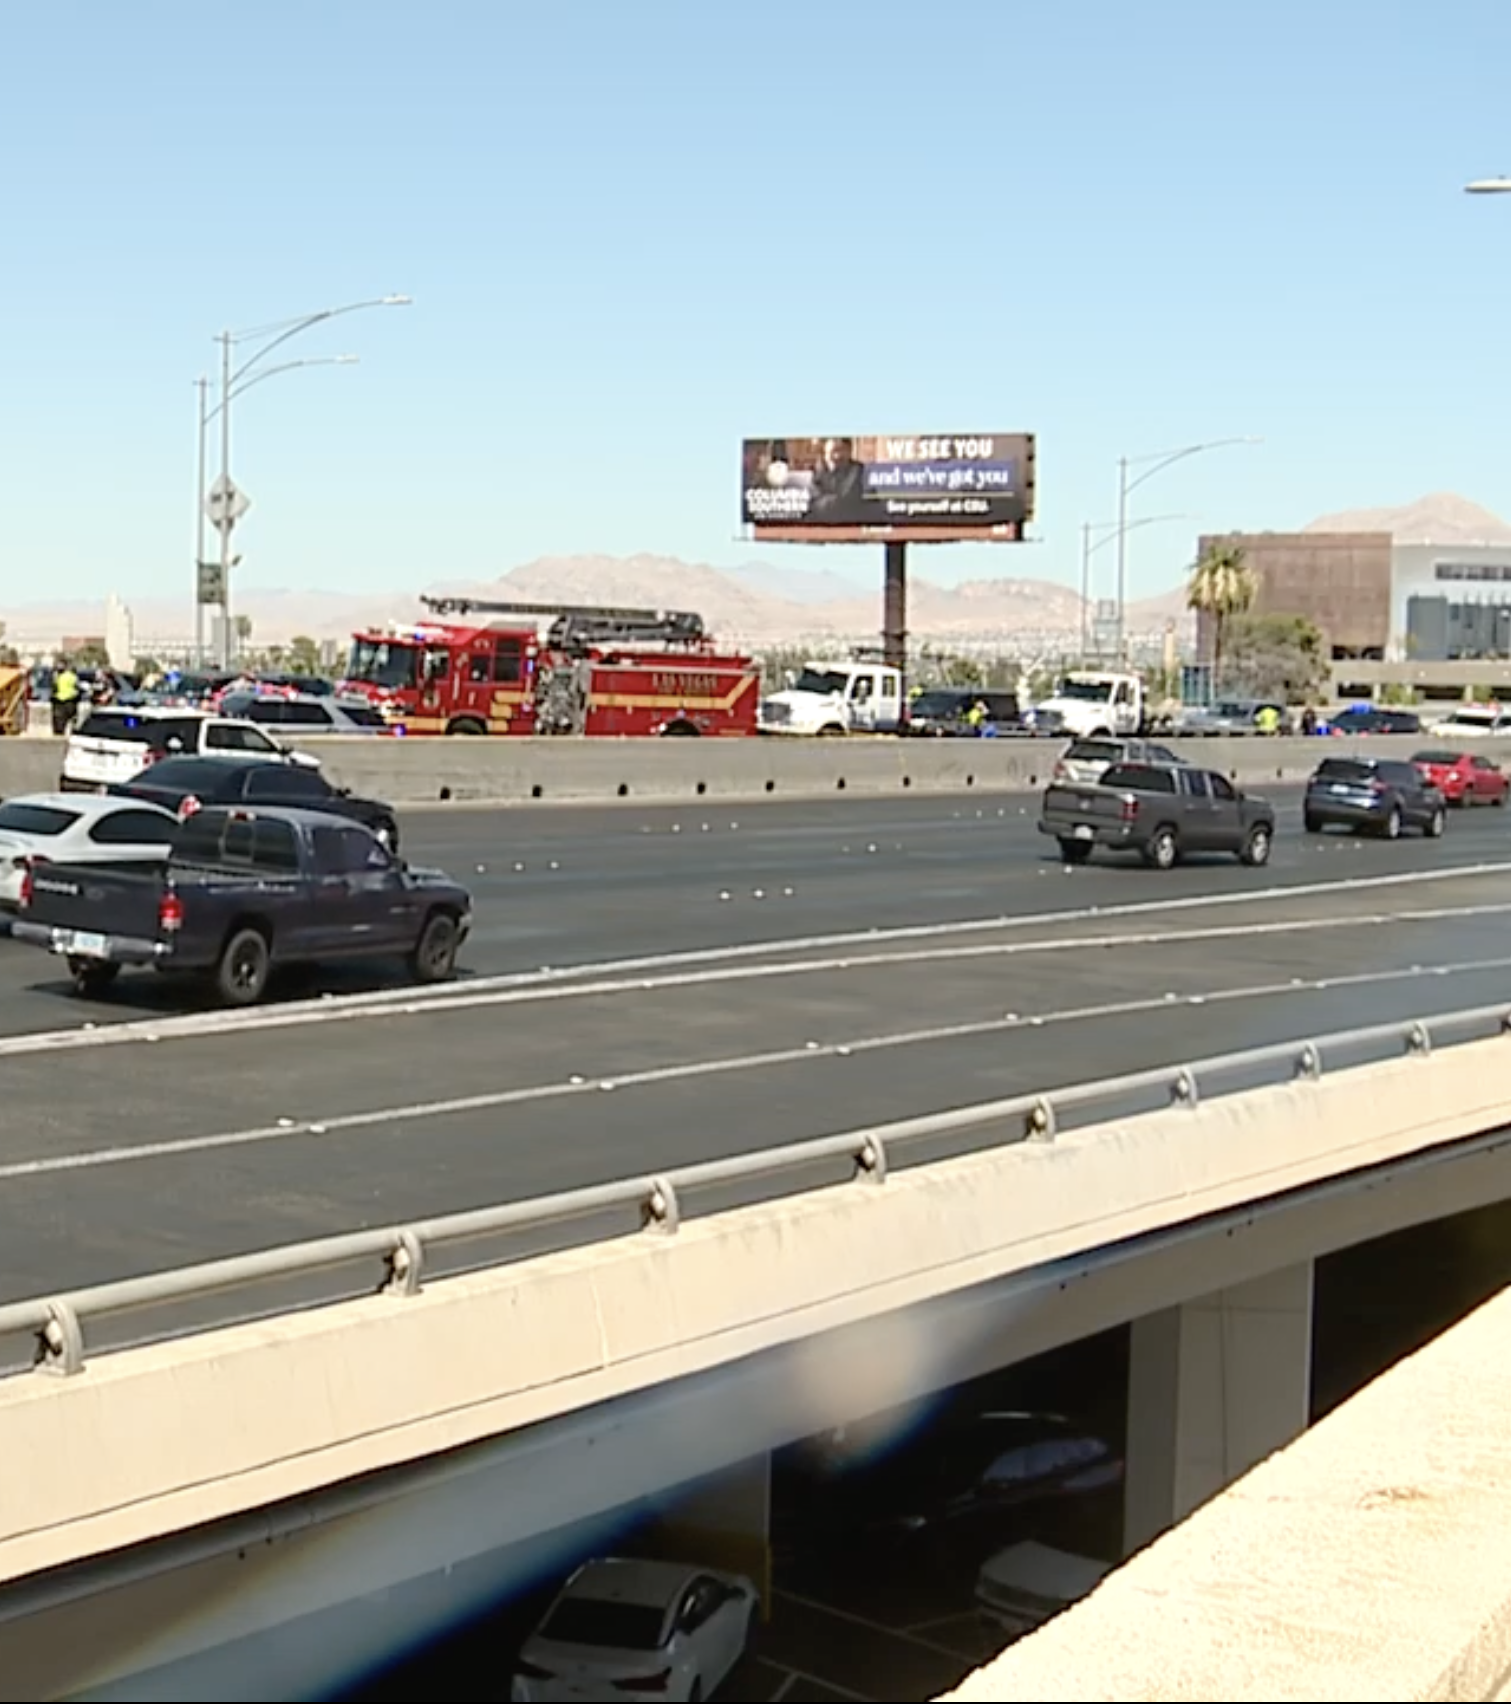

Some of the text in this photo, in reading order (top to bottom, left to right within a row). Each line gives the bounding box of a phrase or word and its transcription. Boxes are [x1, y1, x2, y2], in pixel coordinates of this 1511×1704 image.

[887, 438, 993, 459] WE SEE YOU
[868, 466, 1008, 490] and we've got you
